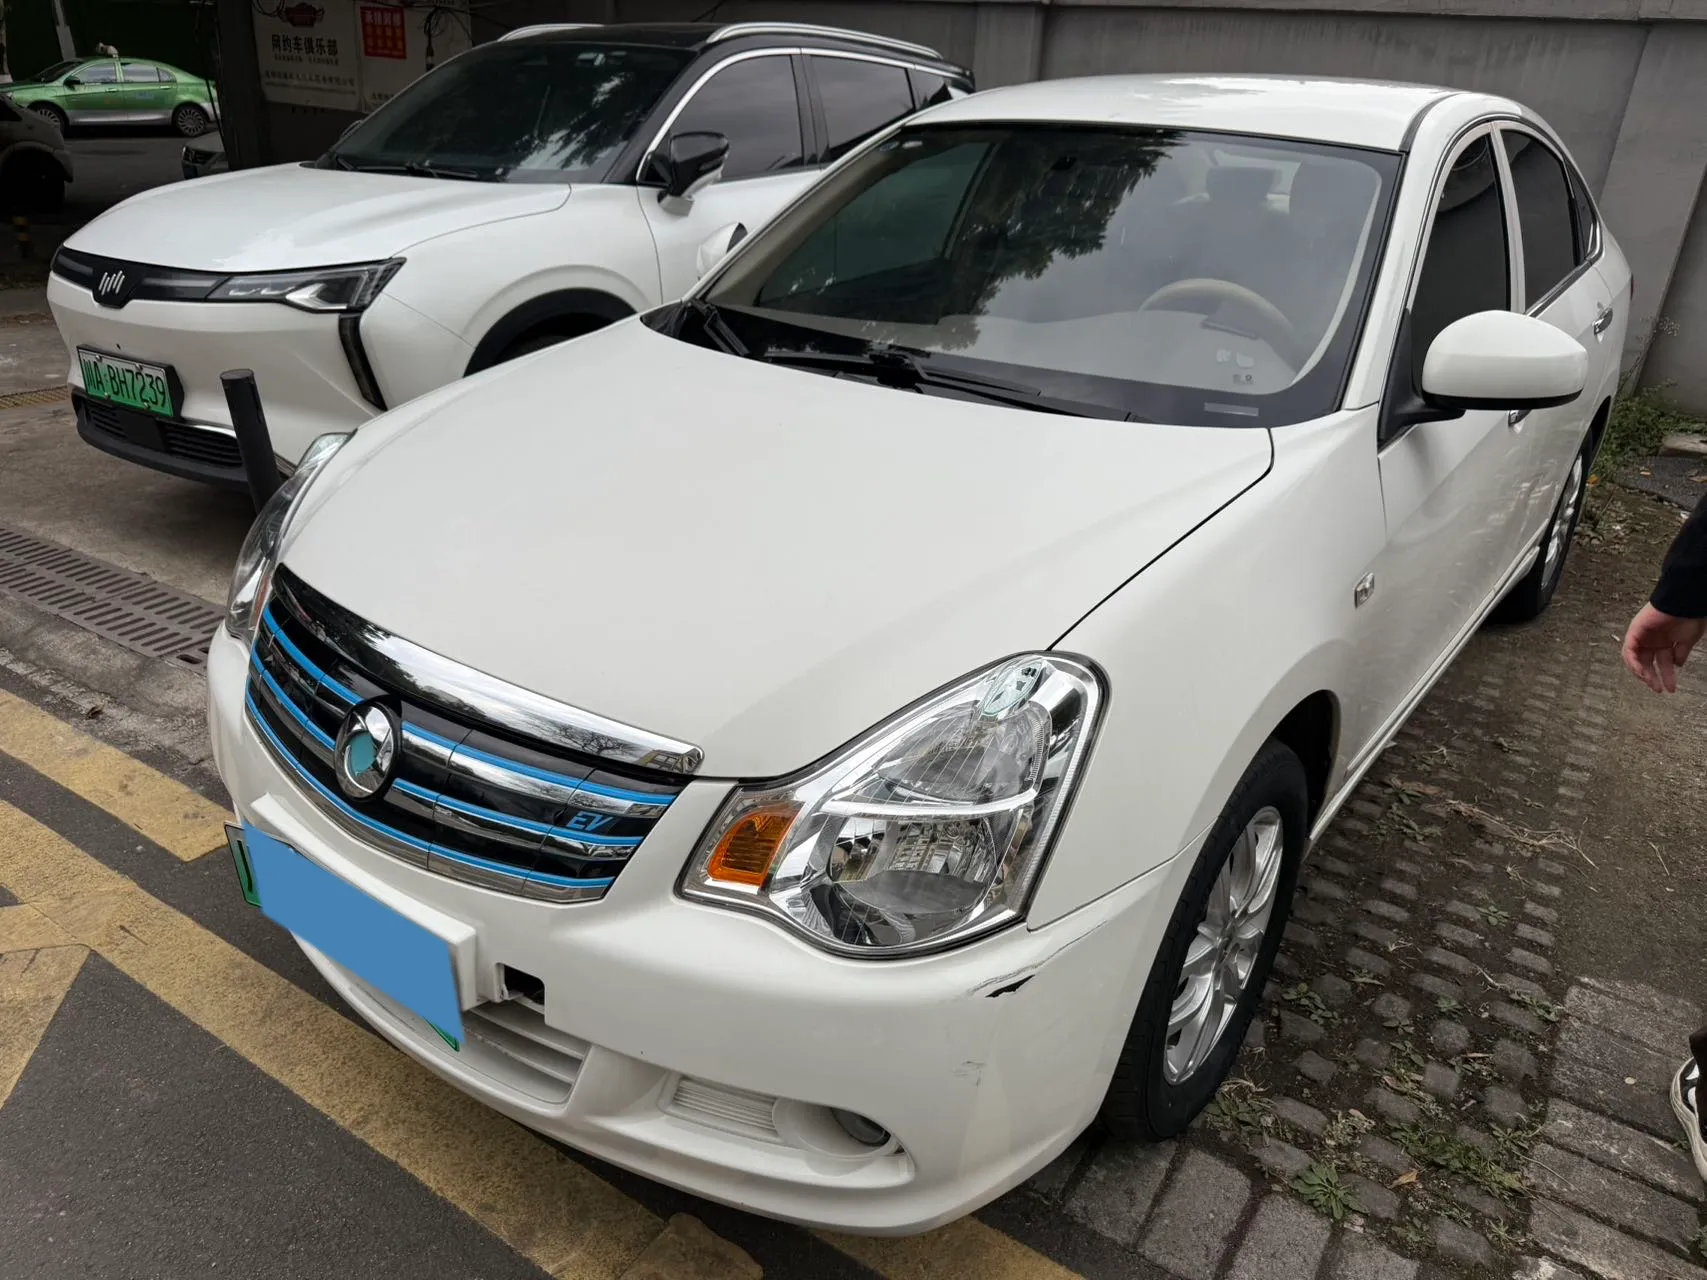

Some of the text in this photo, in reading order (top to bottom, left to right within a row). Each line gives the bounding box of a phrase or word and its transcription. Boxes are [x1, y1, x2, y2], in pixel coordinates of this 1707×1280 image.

[271, 34, 338, 56] 网约车俱乐部
[566, 810, 614, 831] EV
